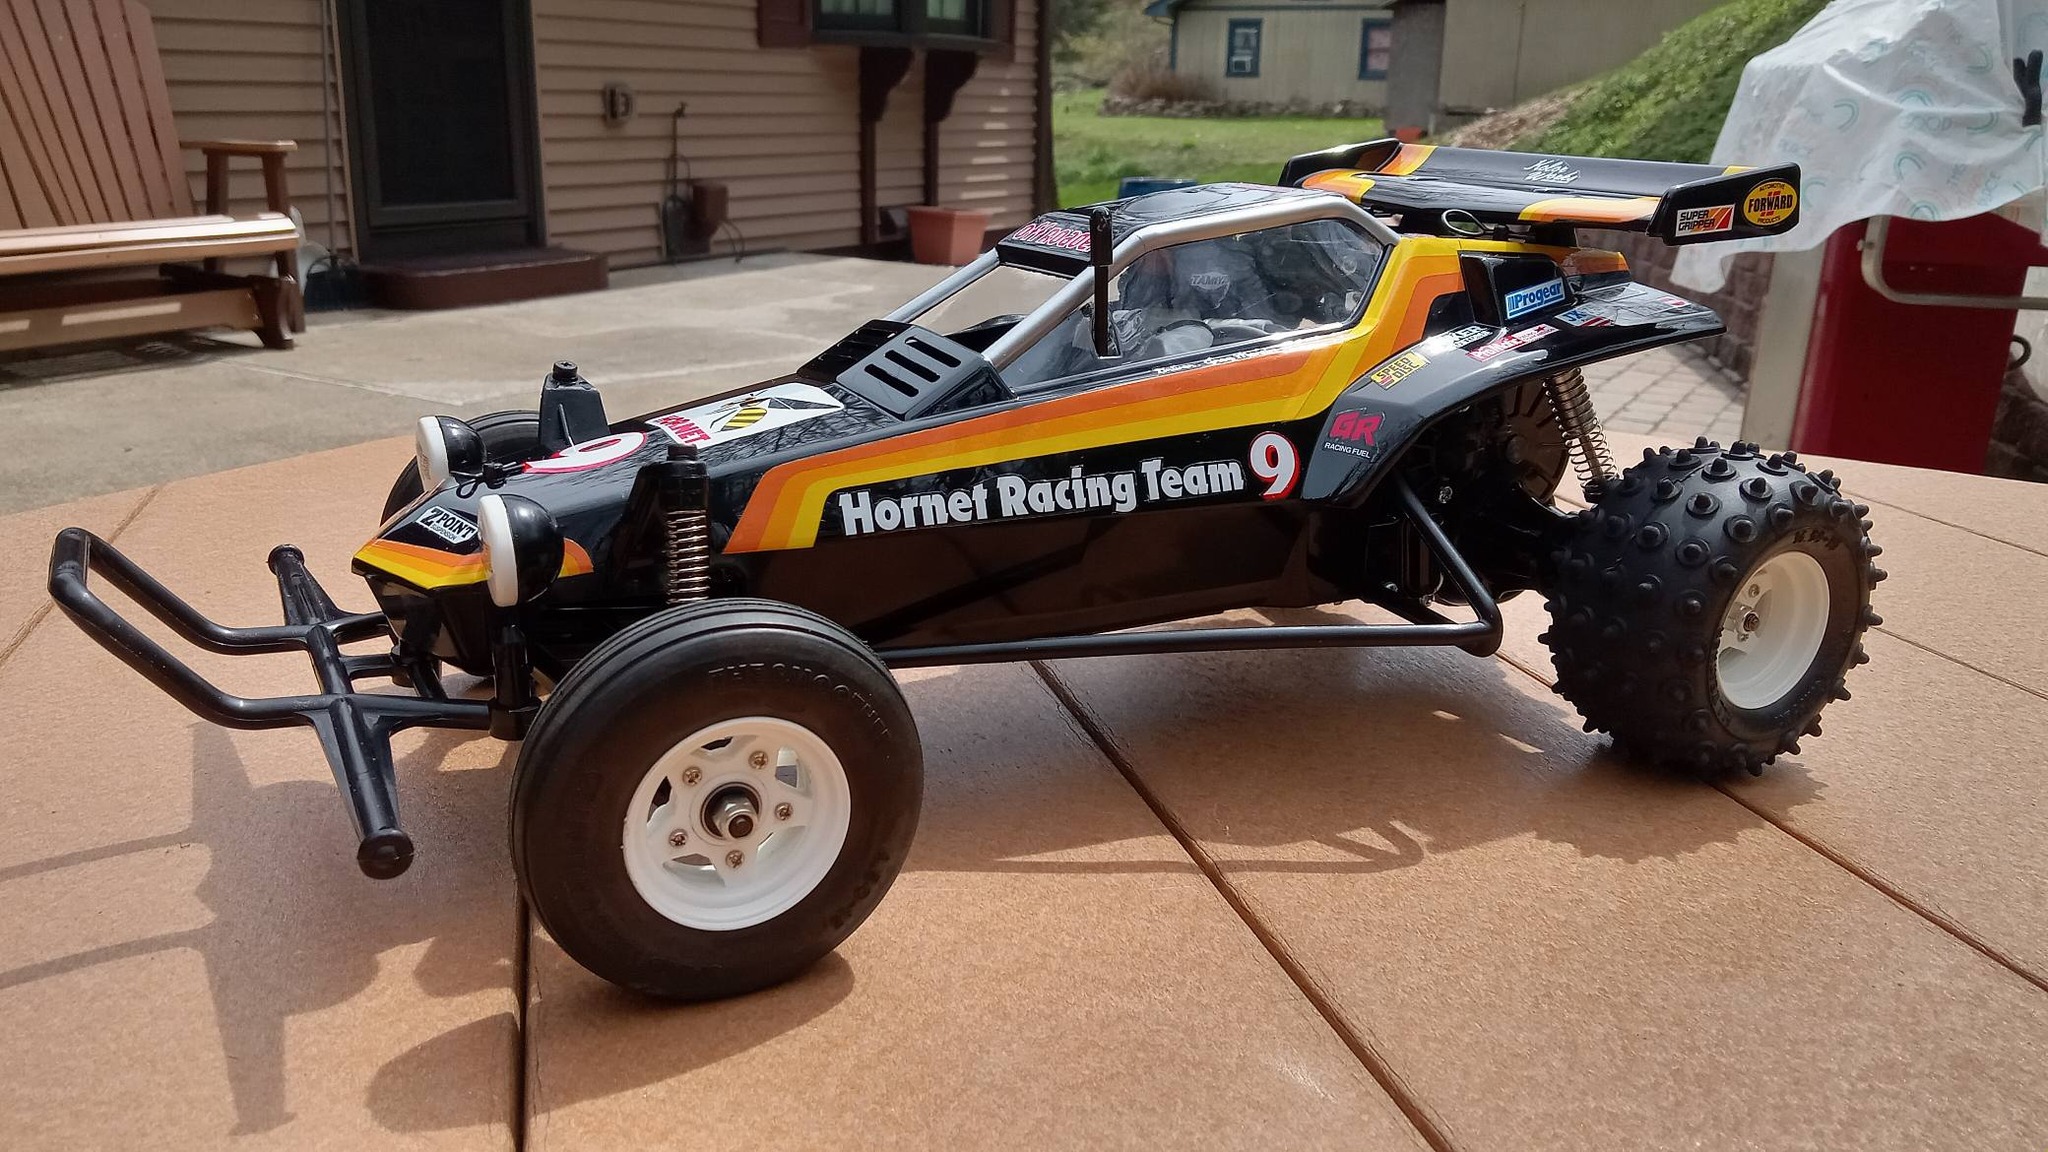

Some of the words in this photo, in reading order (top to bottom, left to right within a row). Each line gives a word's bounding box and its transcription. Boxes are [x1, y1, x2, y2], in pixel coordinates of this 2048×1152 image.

[1747, 194, 1793, 213] FORWARD
[1678, 218, 1716, 232] GRIPPER
[1680, 209, 1710, 220] SUPER
[1513, 282, 1562, 308] Progear
[1376, 356, 1411, 379] SPEED
[1391, 364, 1420, 379] DISC
[1329, 410, 1382, 447] GR
[1324, 442, 1352, 454] RACING
[1350, 448, 1371, 459] FUEL
[1249, 431, 1299, 500] 9
[838, 484, 988, 537] Hornet
[997, 465, 1137, 514] Racing
[1141, 458, 1245, 501] Team
